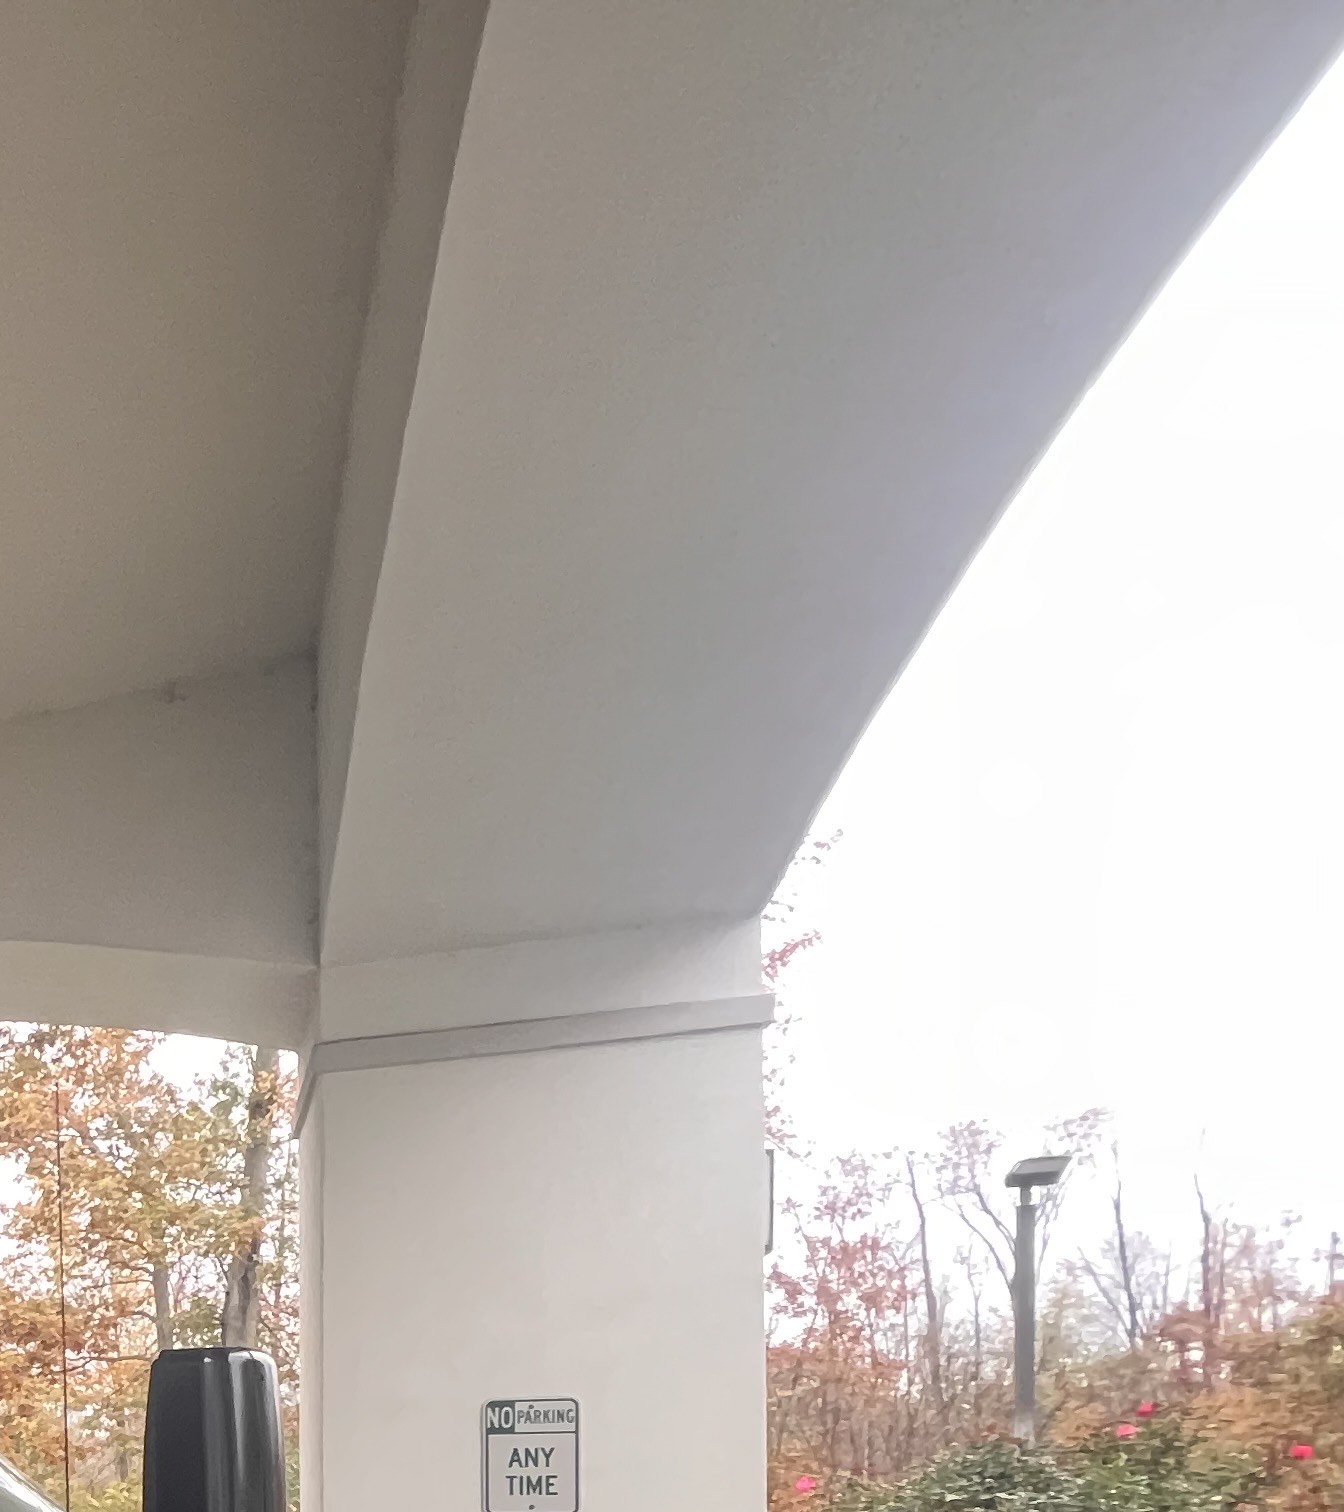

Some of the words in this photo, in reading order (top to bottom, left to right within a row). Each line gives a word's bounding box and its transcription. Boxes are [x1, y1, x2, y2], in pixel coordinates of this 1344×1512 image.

[487, 1406, 513, 1428] NO
[517, 1409, 575, 1424] PARKING
[508, 1447, 555, 1468] ANY
[505, 1475, 558, 1495] TIME
